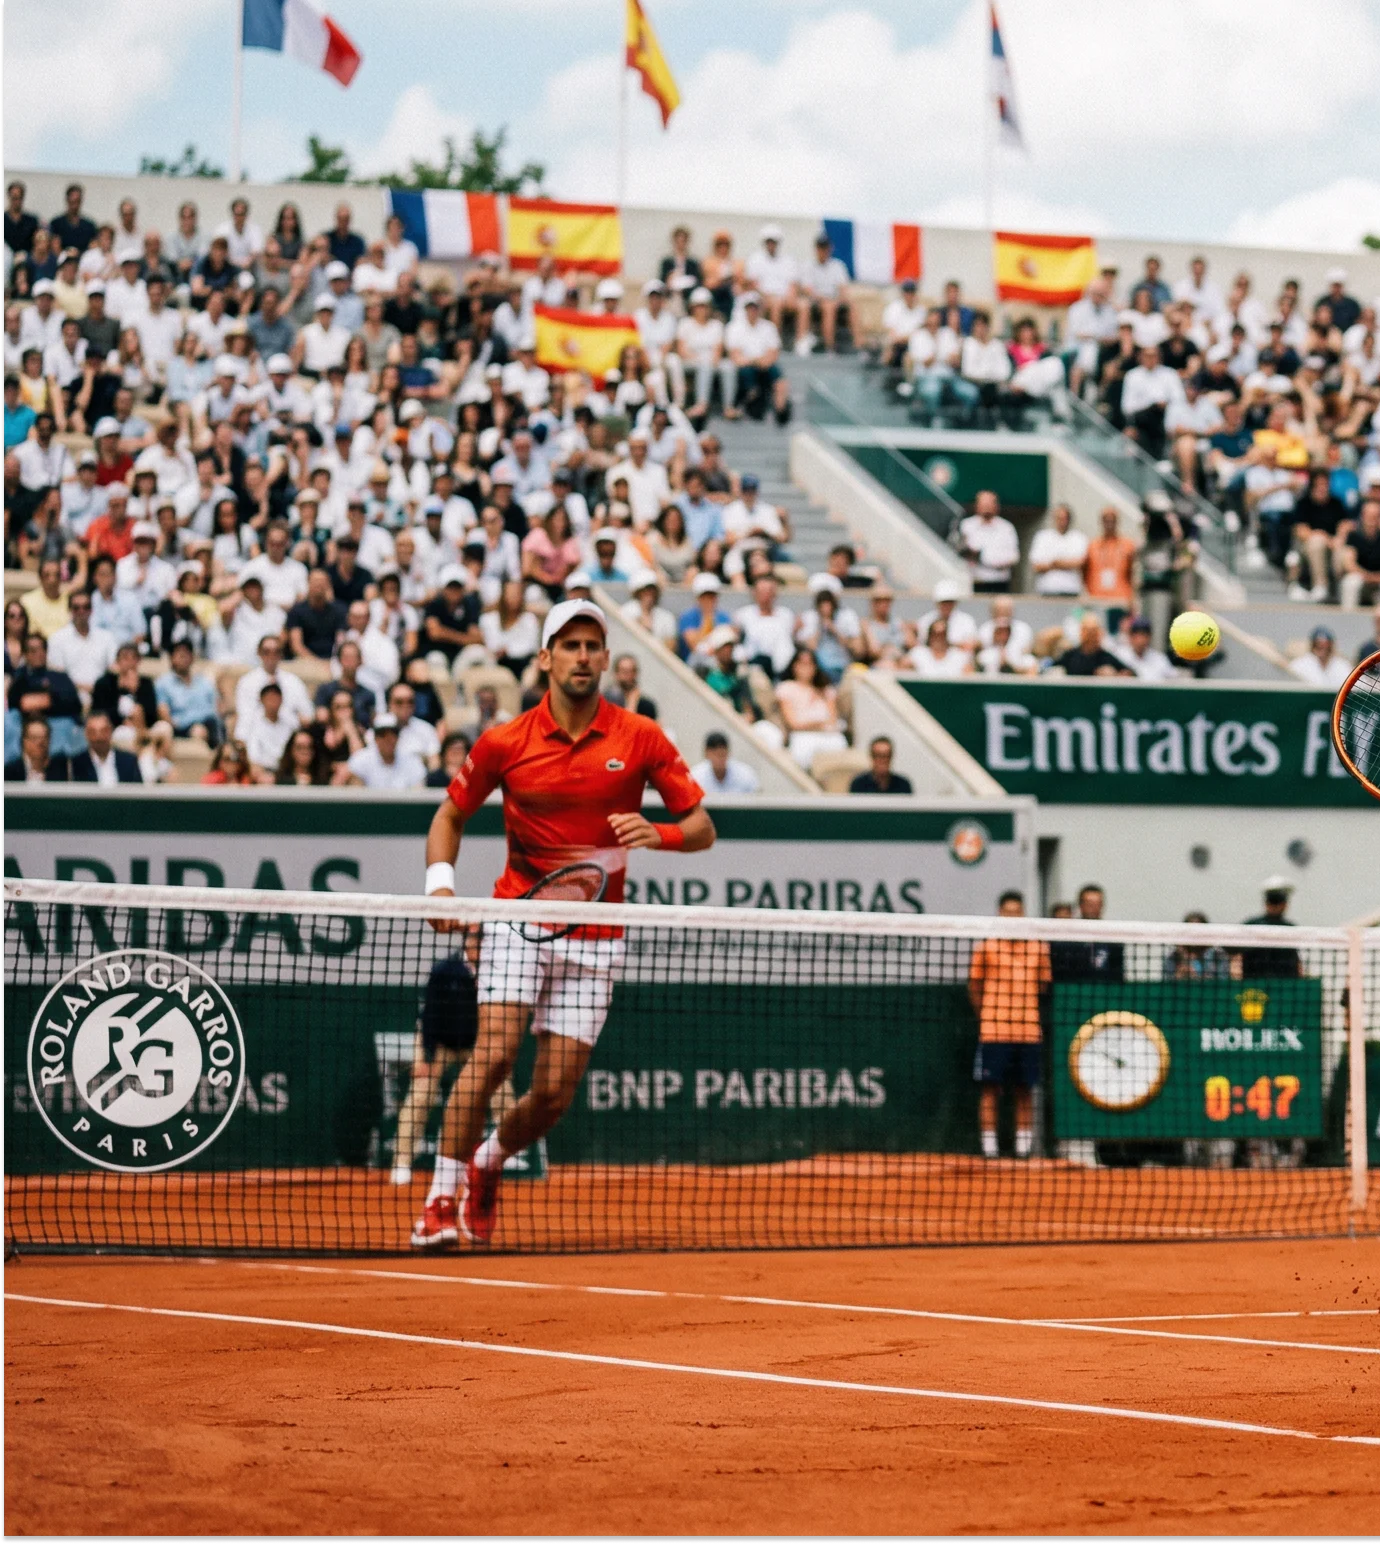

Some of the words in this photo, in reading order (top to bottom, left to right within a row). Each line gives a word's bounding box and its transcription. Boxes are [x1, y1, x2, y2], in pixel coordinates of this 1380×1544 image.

[983, 701, 1281, 776] Emirates
[726, 880, 924, 914] PARIBAS
[39, 961, 132, 1088] ROLAND
[144, 962, 235, 1088] GARROS
[1200, 1027, 1304, 1051] ROLEX
[587, 1069, 684, 1112] BNP
[694, 1066, 888, 1109] PARIBAS
[1204, 1074, 1300, 1121] 0:47
[72, 1116, 200, 1157] PARIS
